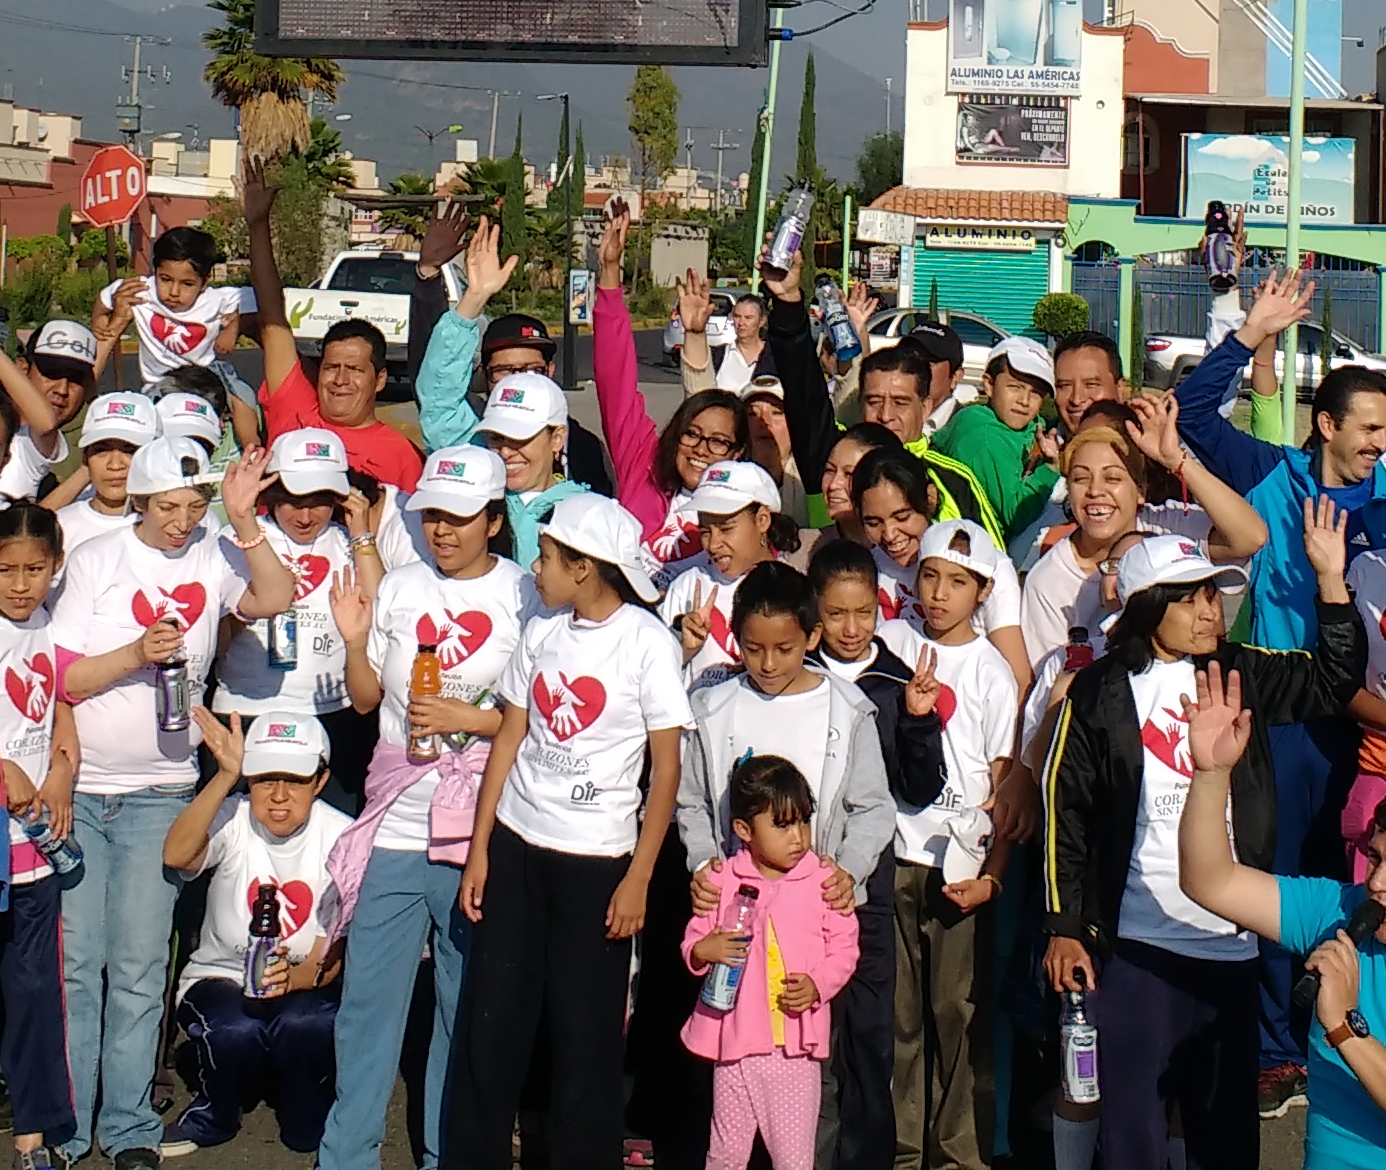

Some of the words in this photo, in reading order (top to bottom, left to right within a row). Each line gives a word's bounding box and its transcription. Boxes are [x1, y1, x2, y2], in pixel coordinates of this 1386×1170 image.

[950, 67, 1004, 79] ALUMINIO
[1006, 68, 1025, 79] LAS
[1027, 67, 1081, 82] AMÉRICAS
[84, 166, 142, 211] ALTO
[1265, 204, 1285, 215] DE
[1300, 204, 1336, 217] IÑOS
[929, 226, 1033, 241] ALUMINIO
